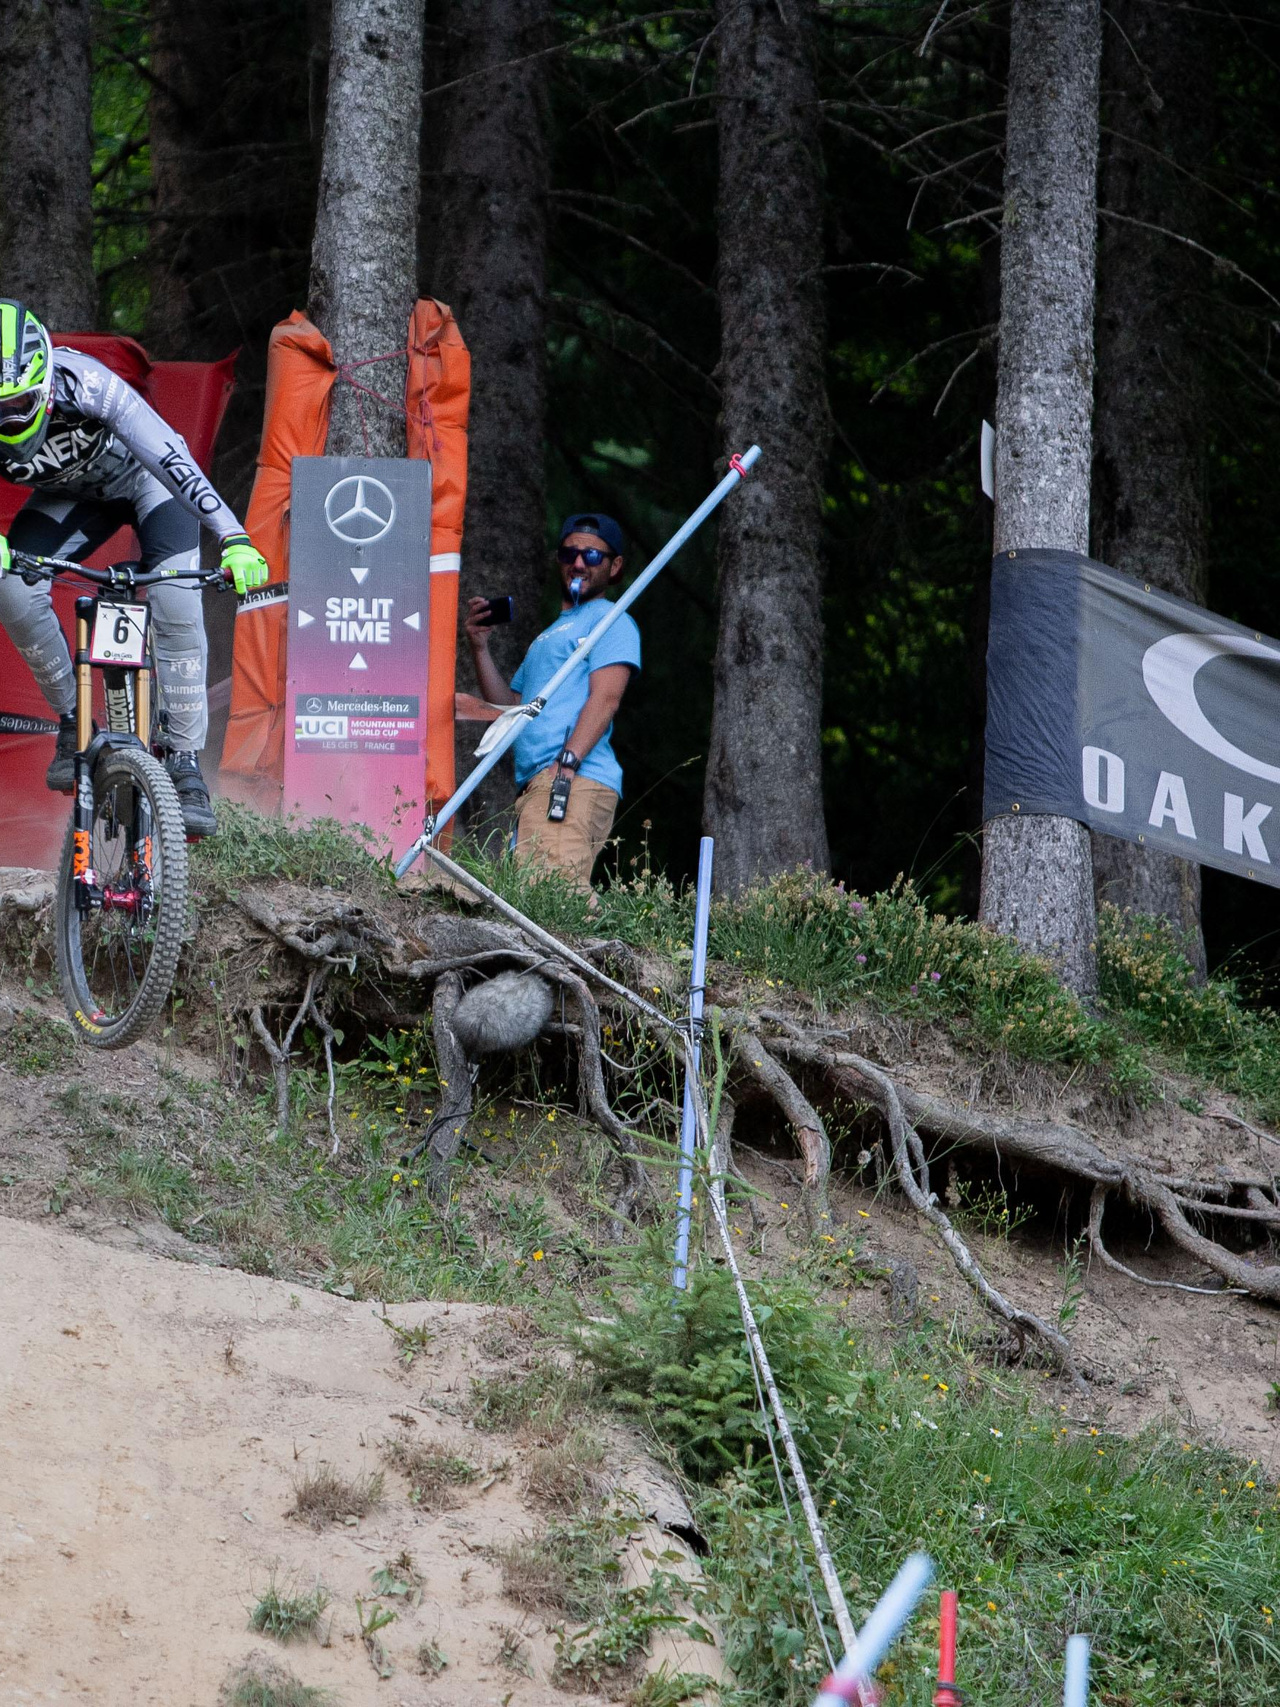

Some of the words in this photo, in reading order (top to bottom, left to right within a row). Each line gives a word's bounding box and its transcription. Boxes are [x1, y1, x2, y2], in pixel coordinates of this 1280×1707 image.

[325, 597, 393, 619] SPLIT
[113, 616, 130, 644] 6
[326, 621, 390, 642] TIME
[327, 699, 410, 713] Mercedes-Benz
[304, 721, 344, 736] UCI
[350, 720, 396, 729] MOUNTAIN
[396, 721, 415, 729] BIKE
[381, 729, 399, 737] CUP
[322, 741, 336, 749] LES
[337, 741, 359, 749] GETS
[364, 742, 395, 750] FRANCE
